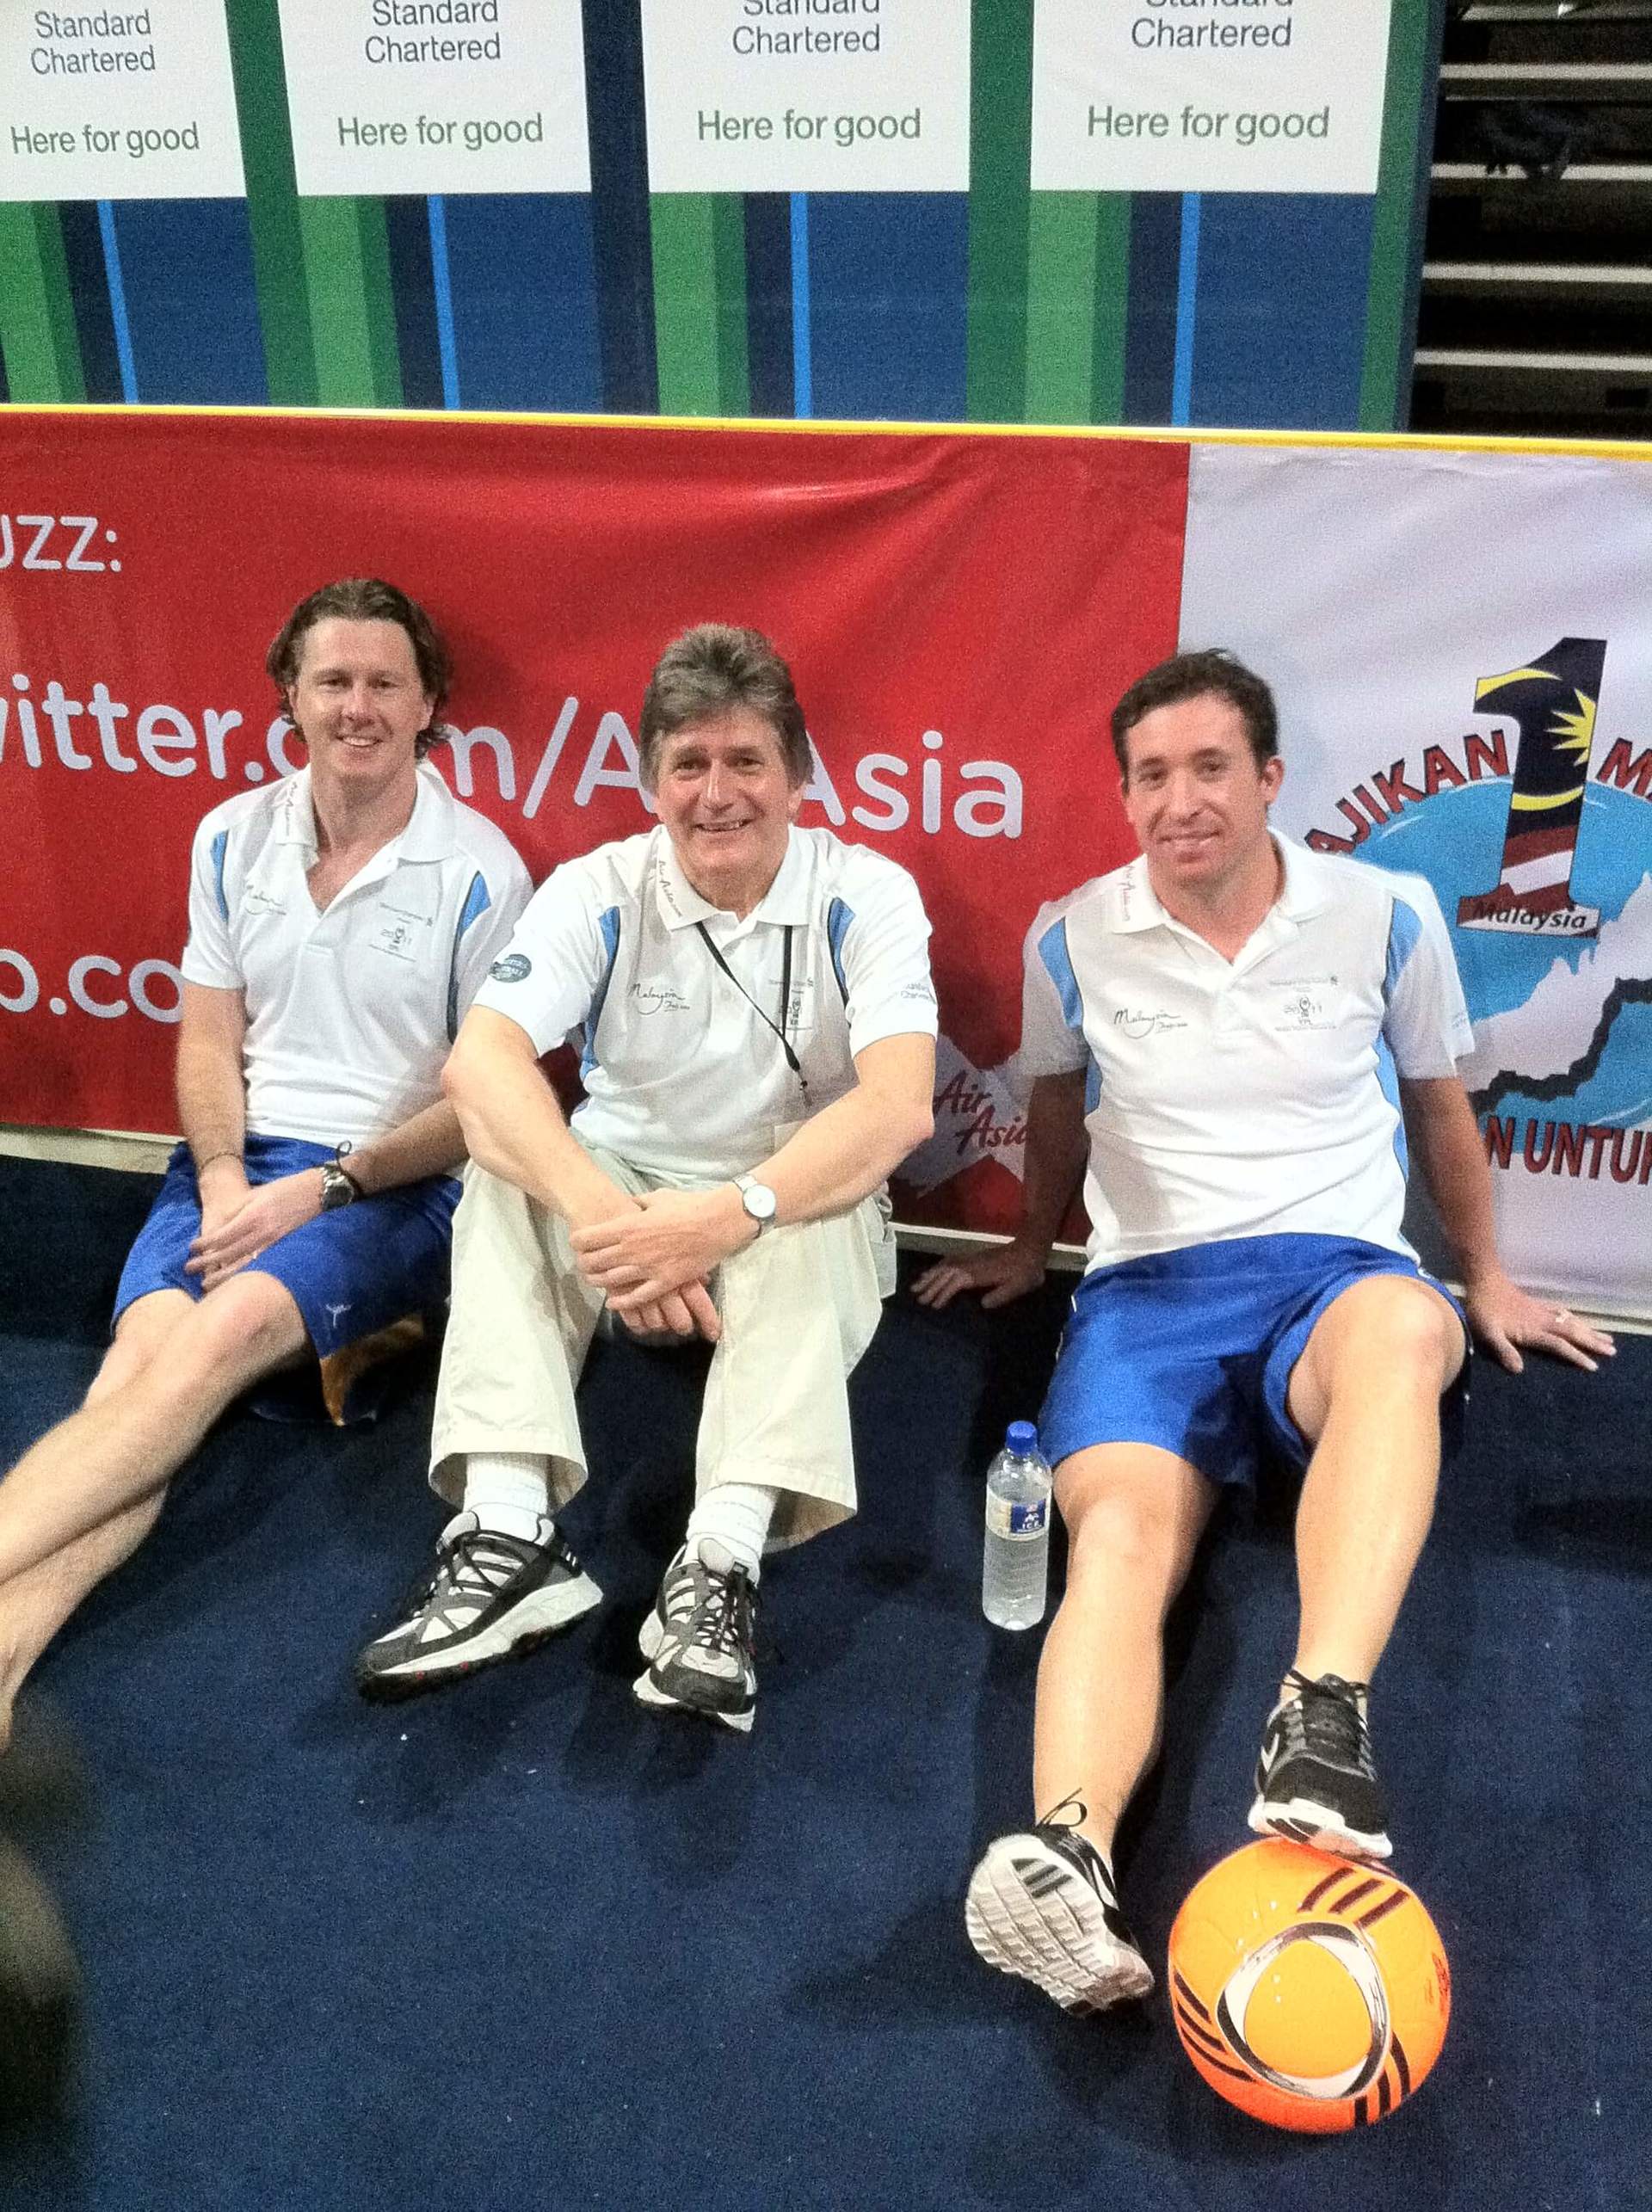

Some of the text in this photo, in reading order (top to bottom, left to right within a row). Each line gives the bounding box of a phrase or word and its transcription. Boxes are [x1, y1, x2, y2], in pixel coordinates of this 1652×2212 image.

[34, 9, 151, 39] Standard
[373, 0, 498, 26] Standard
[365, 32, 501, 63] Chartered
[733, 24, 880, 54] Chartered
[1131, 17, 1291, 48] Chartered
[31, 45, 156, 75] Chartered
[10, 121, 200, 158] Here for good
[338, 113, 543, 151] Here for good
[698, 108, 921, 147] Here for good
[1088, 104, 1329, 146] Here for good
[1595, 737, 1652, 803] M
[1472, 899, 1587, 931] Malaysia
[933, 1069, 992, 1118] Air
